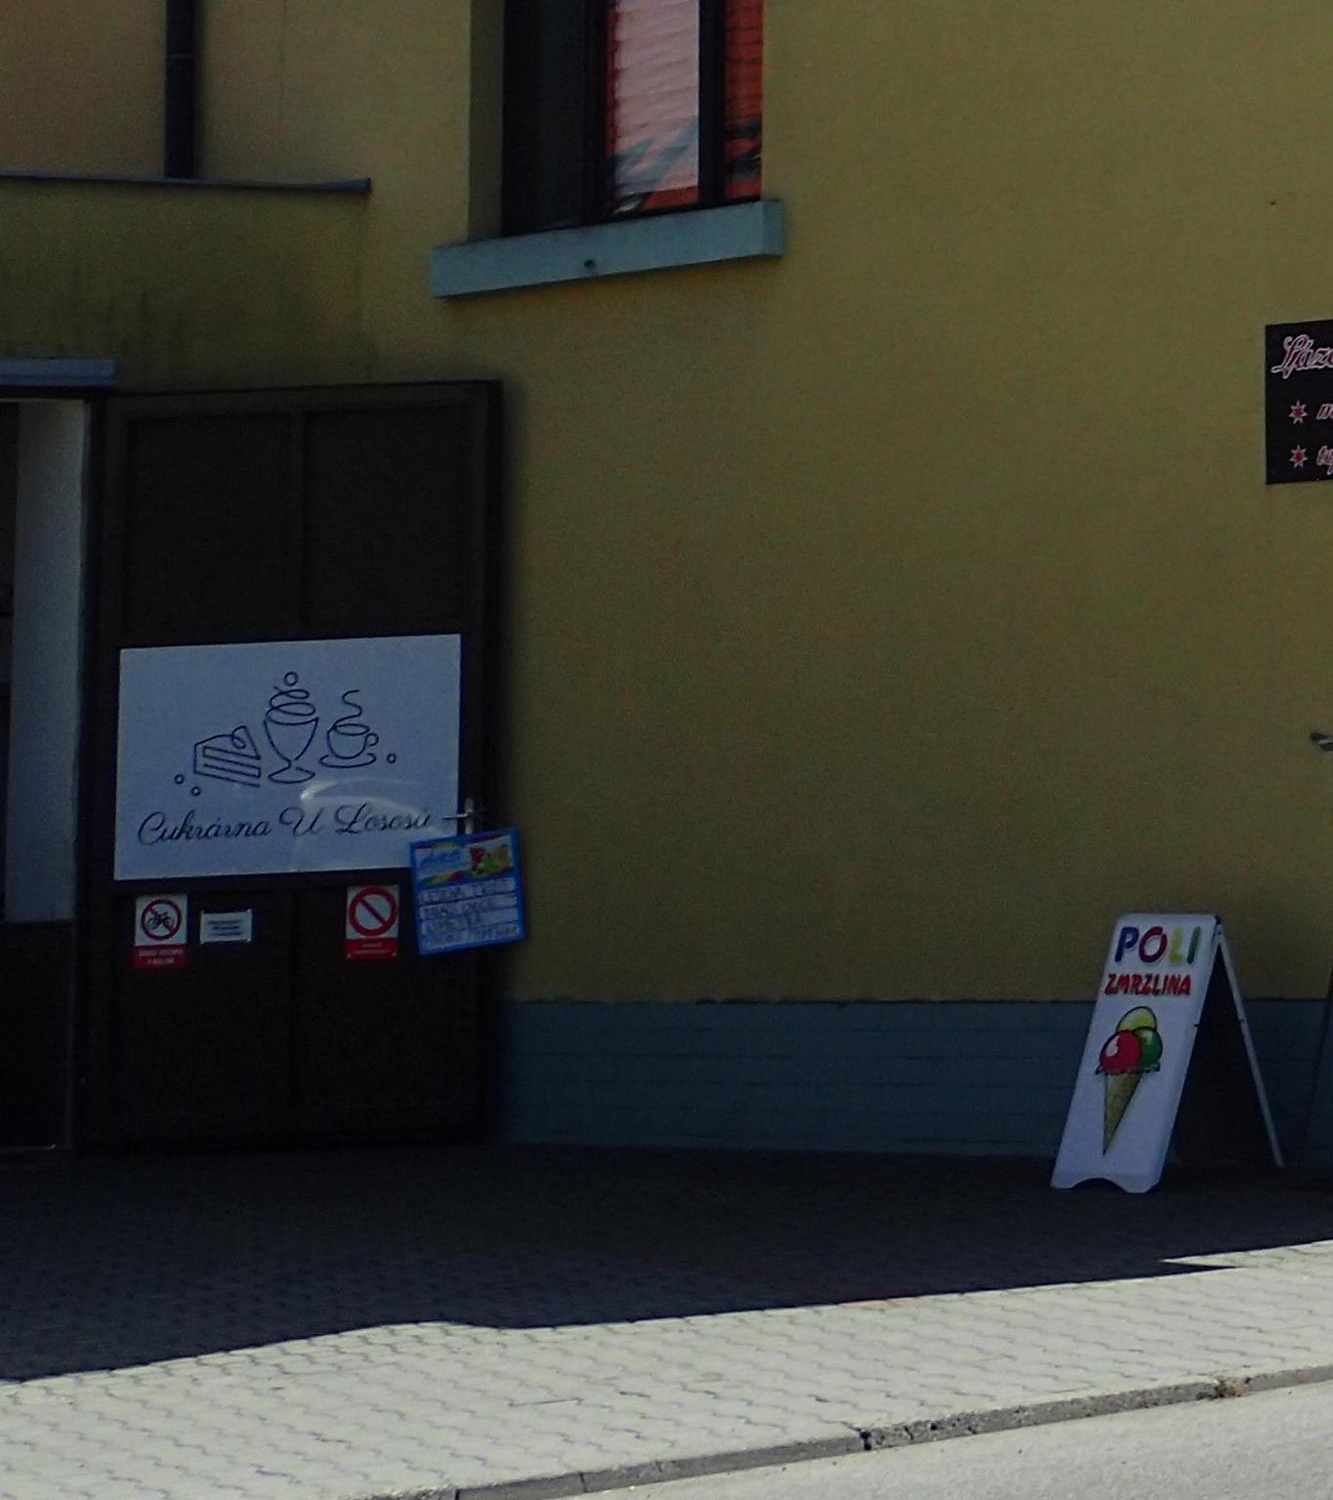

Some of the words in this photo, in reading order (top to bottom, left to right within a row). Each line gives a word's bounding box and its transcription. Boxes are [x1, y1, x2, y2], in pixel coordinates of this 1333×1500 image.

[137, 811, 273, 845] Cukrárna
[279, 806, 324, 838] U
[334, 802, 432, 836] Lososů
[1114, 925, 1203, 964] POLI
[1104, 972, 1192, 996] ZMRZLINA
